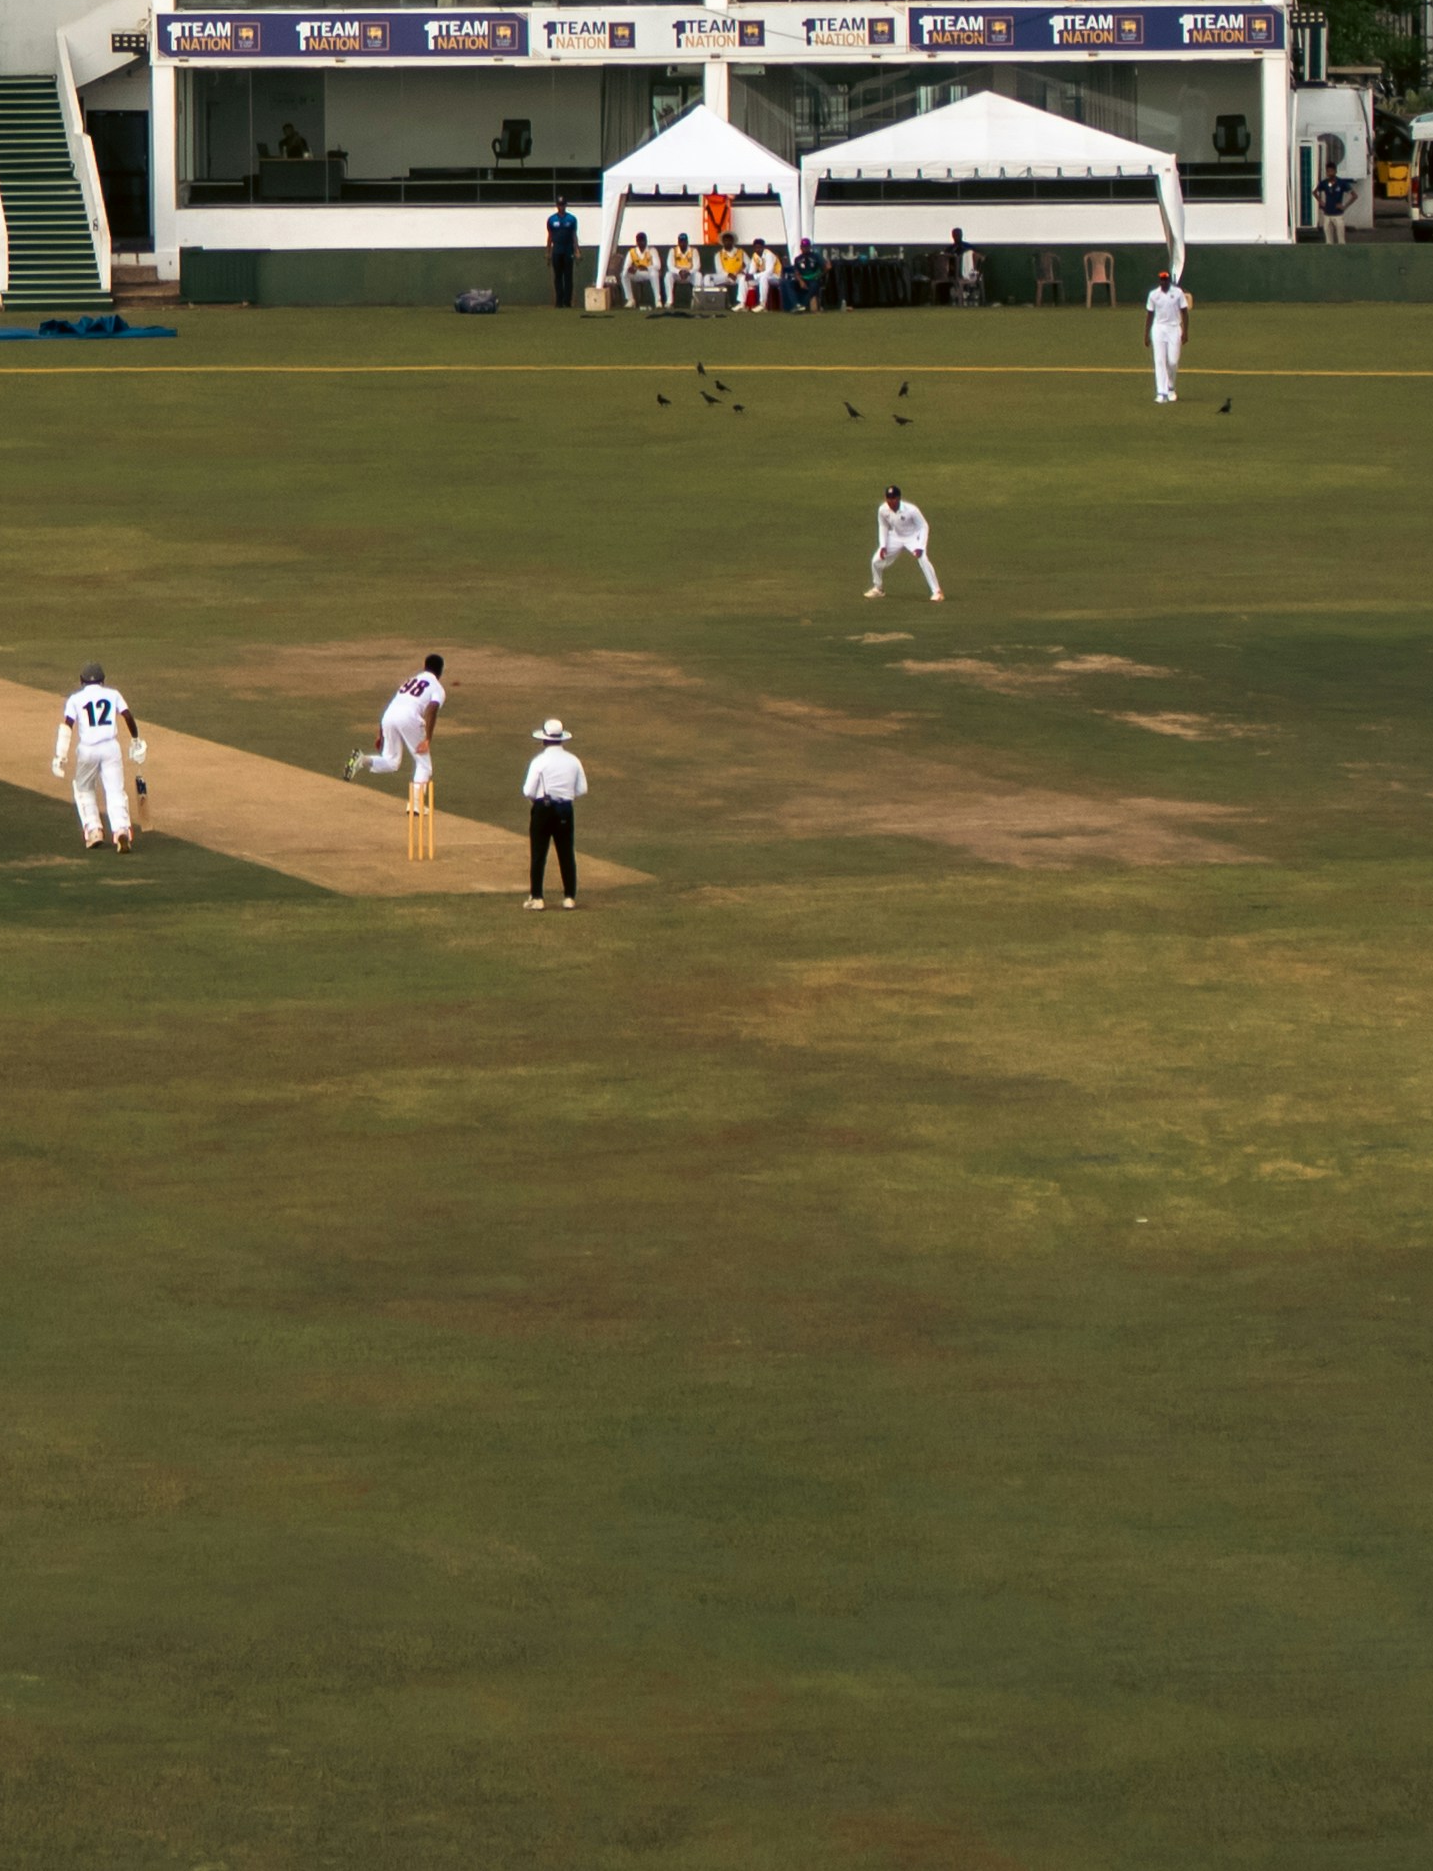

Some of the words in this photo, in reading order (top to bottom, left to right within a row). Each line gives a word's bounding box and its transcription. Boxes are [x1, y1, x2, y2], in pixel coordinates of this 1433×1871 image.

[438, 35, 489, 50] NATION
[556, 35, 606, 49] NATION
[686, 34, 736, 48] NATION
[815, 32, 866, 46] NATION
[933, 30, 983, 45] NATION
[1063, 30, 1114, 44] NATION
[1193, 29, 1244, 43] NATION
[180, 37, 231, 52] NATION
[309, 36, 360, 51] NATION
[83, 699, 112, 727] 12
